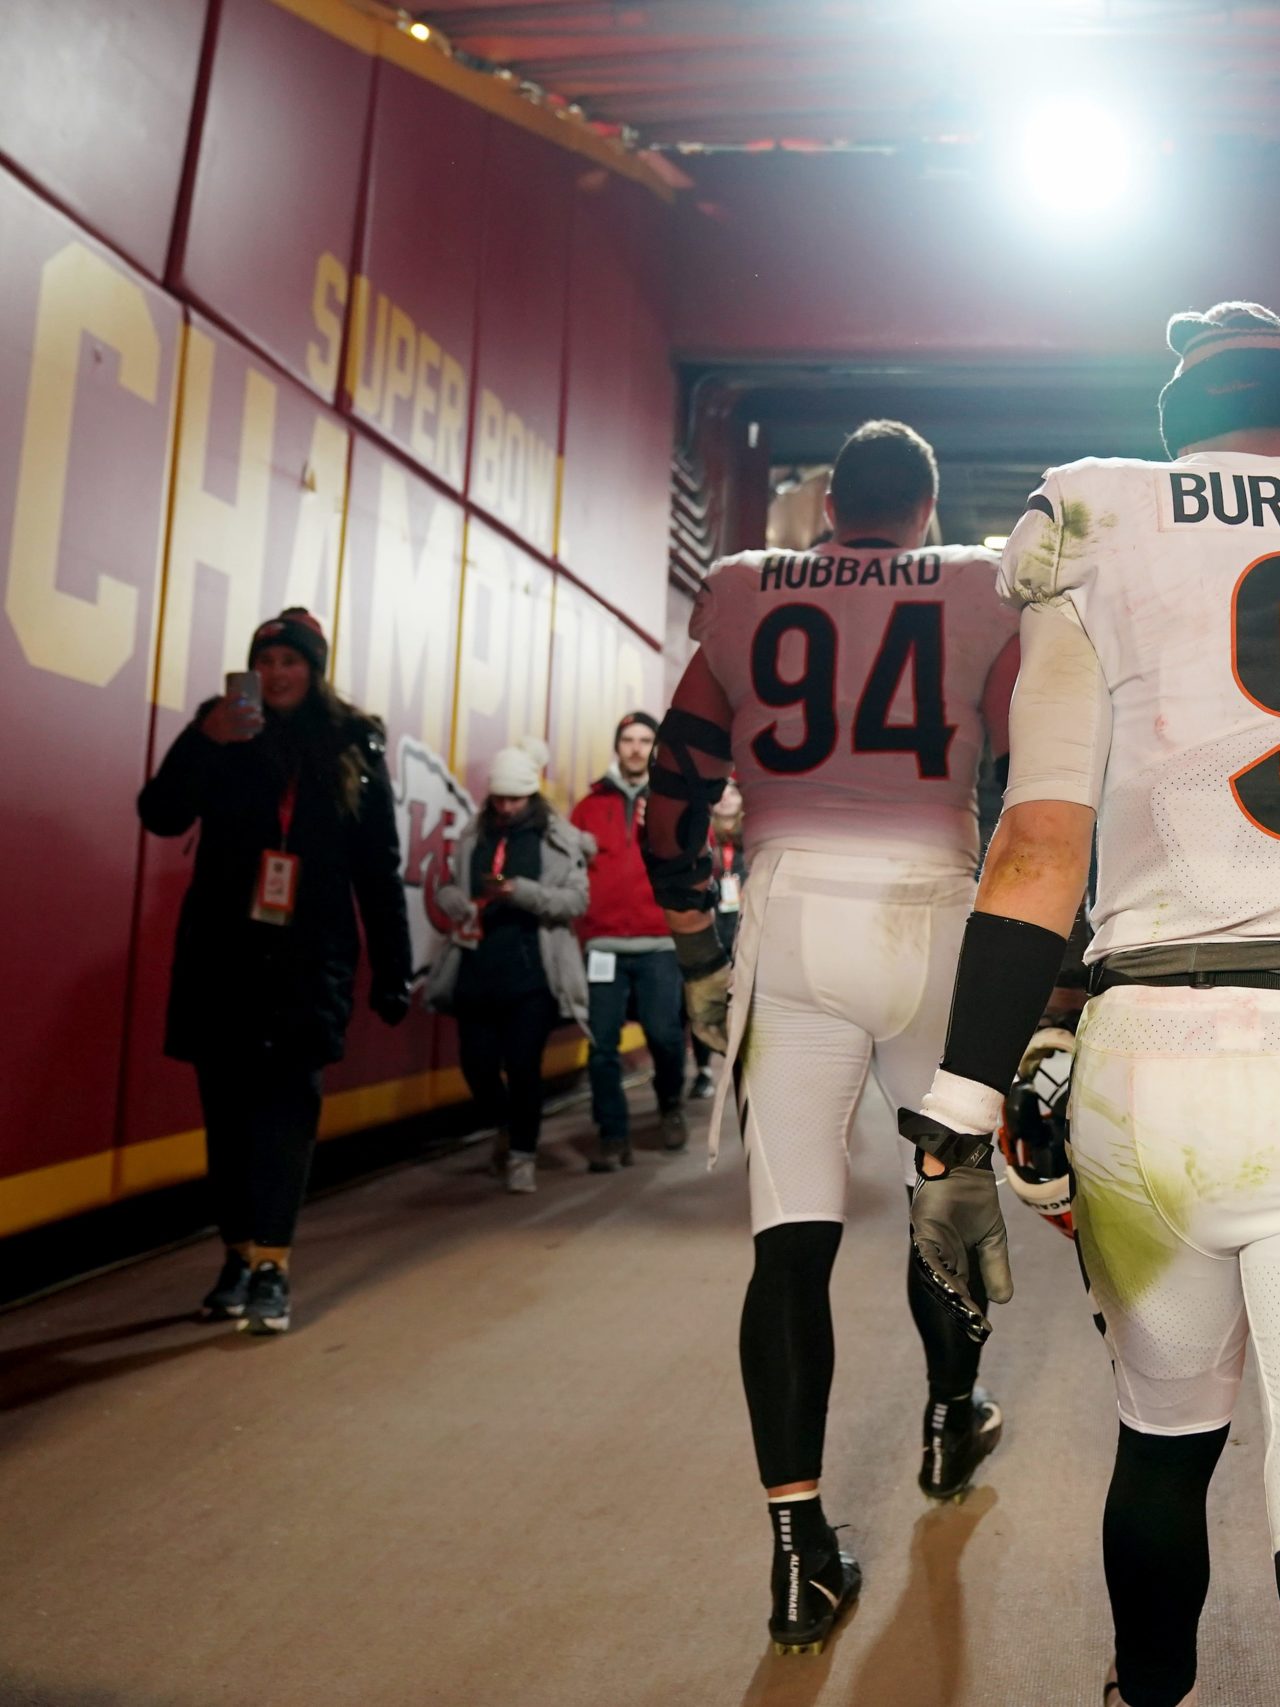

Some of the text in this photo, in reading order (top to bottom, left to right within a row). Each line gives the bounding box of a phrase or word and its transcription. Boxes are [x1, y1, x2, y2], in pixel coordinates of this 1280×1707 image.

[306, 249, 568, 558] SUPER BOWL
[760, 553, 941, 591] HUBBARD
[750, 601, 958, 780] 94
